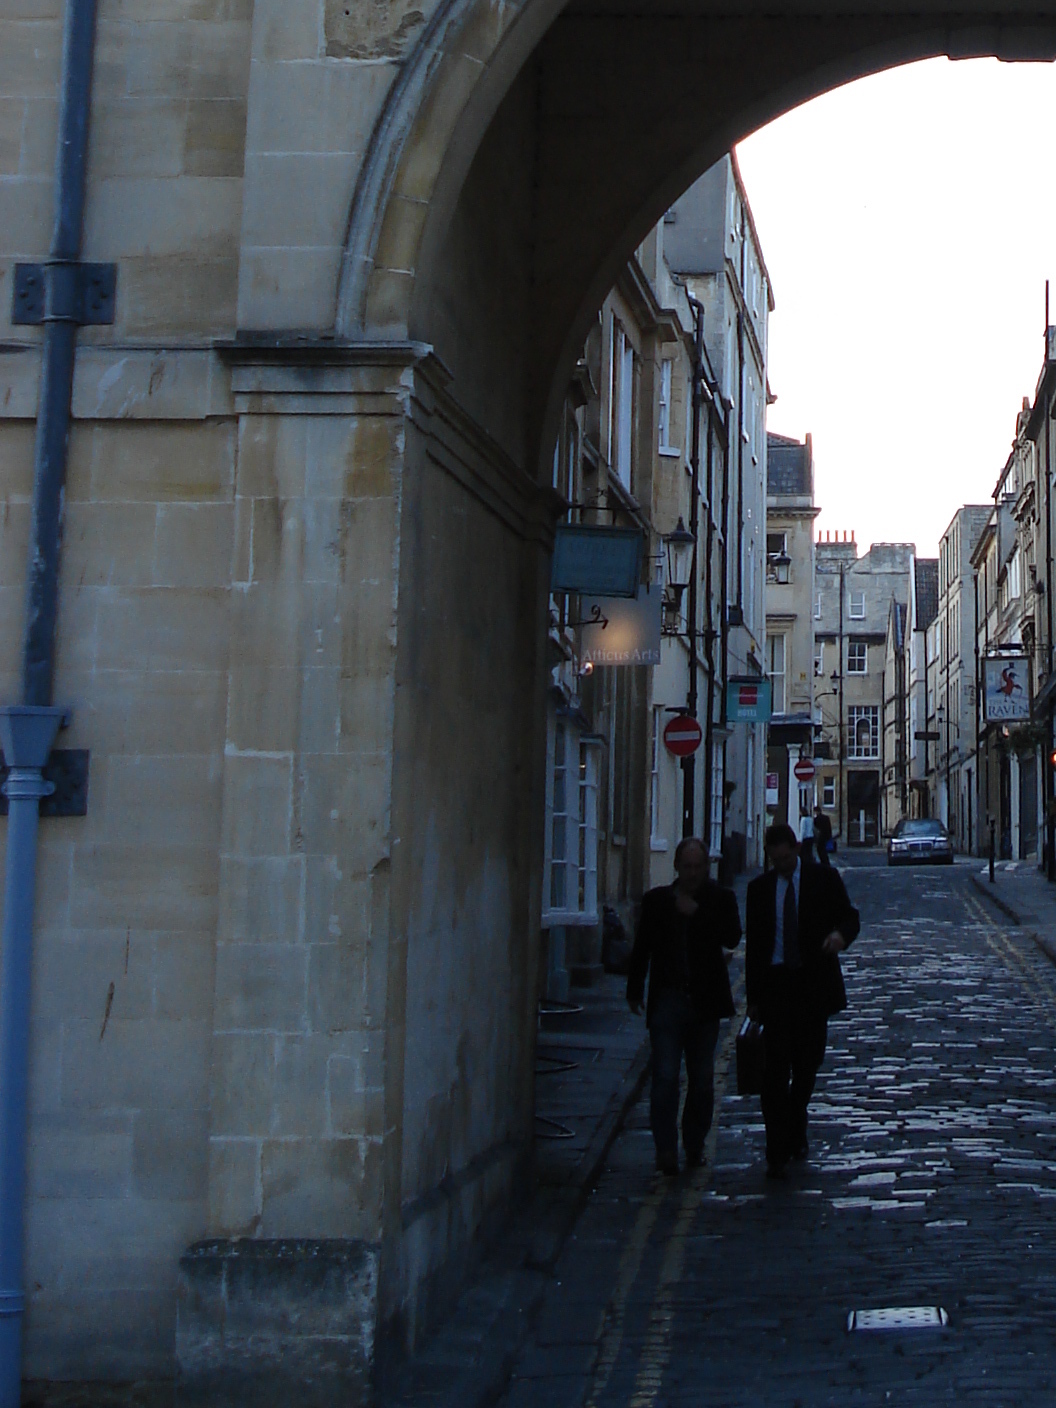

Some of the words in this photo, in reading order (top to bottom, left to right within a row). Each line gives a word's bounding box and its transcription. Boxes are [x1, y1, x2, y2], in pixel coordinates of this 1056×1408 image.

[582, 648, 629, 661] Atticus
[632, 648, 659, 660] Arts
[988, 705, 1029, 717] RAVEN
